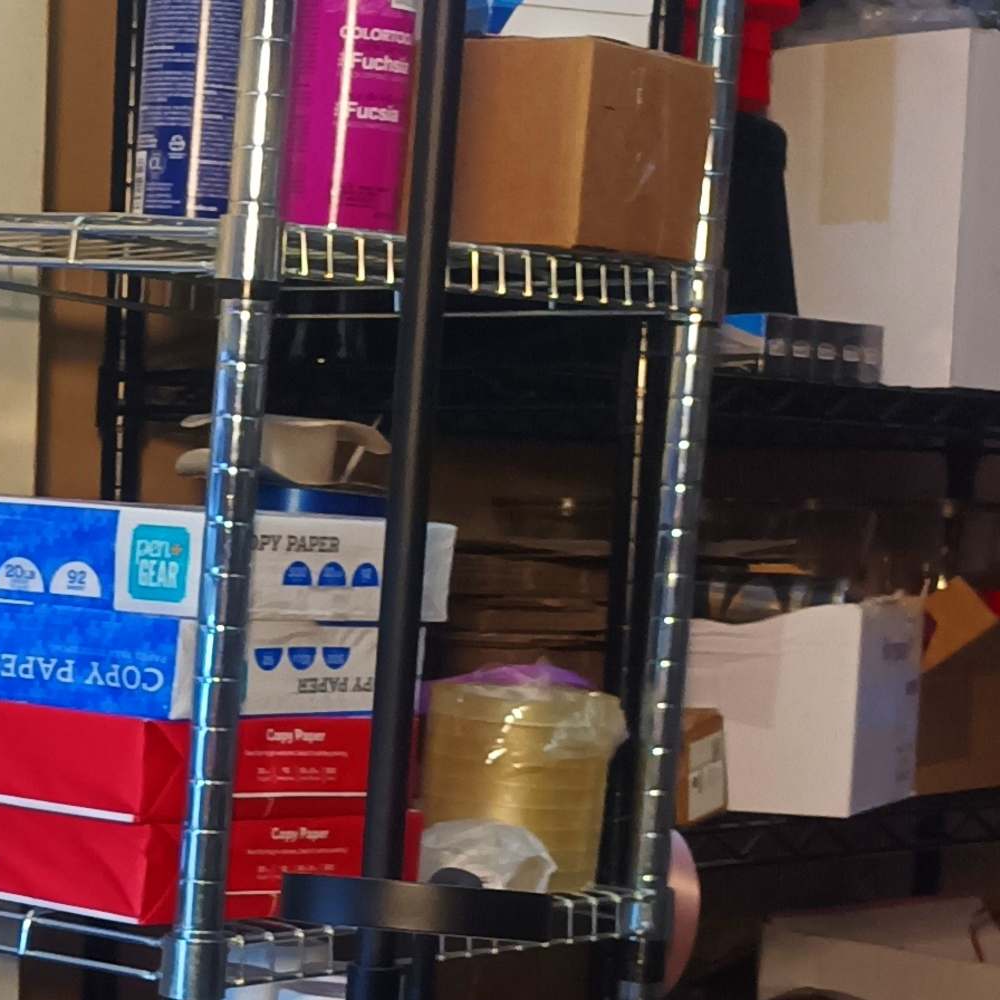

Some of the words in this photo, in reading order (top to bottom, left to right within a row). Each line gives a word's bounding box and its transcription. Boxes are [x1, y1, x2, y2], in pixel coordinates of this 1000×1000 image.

[135, 538, 172, 564] pen
[285, 535, 341, 553] PAPER
[66, 568, 88, 585] 92
[137, 559, 180, 589] GEAR
[84, 661, 165, 693] COPY
[265, 728, 294, 744] Copy
[294, 728, 327, 744] Paper
[270, 826, 298, 842] Copy
[298, 826, 330, 842] Paper
